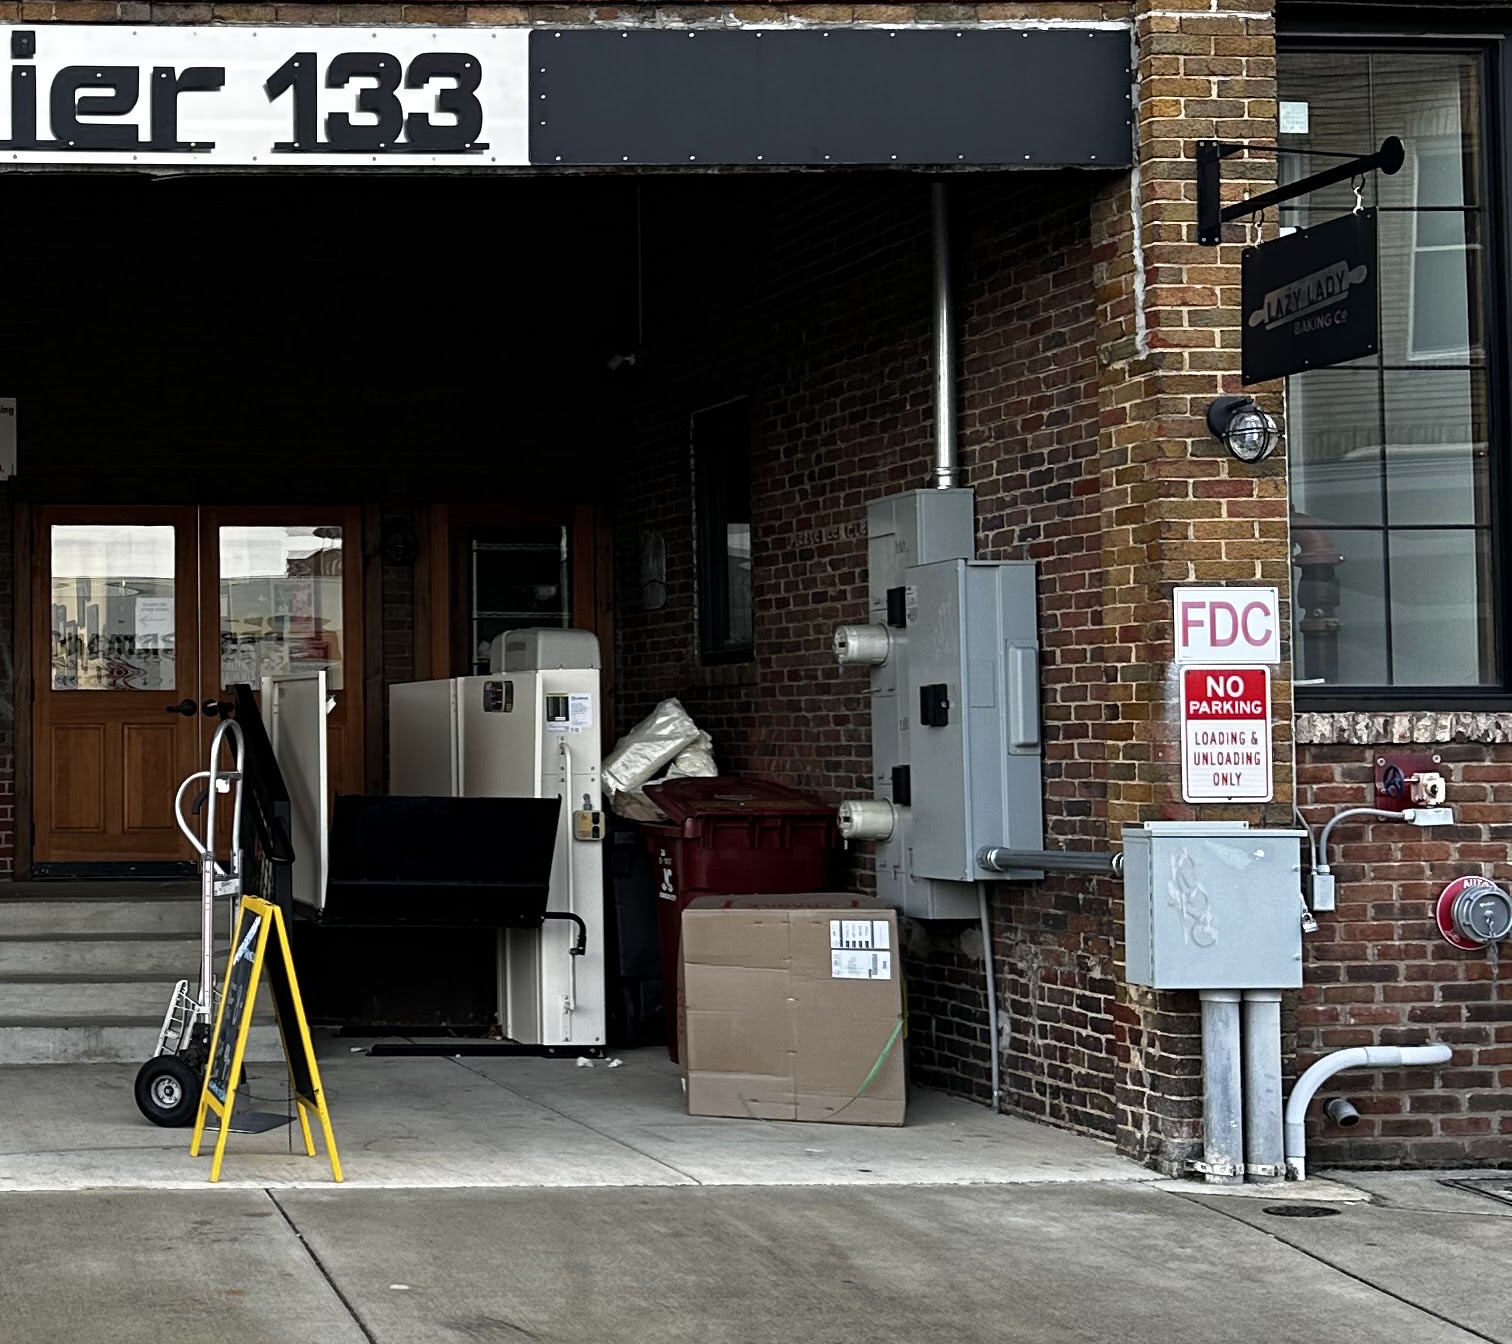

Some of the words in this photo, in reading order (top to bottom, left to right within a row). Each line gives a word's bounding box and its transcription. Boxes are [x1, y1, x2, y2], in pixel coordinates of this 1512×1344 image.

[264, 51, 489, 152] 133
[1267, 287, 1302, 321] LAZY
[1307, 270, 1345, 304] LADY
[1294, 313, 1332, 335] BAKING
[1181, 601, 1273, 647] FDC
[1206, 675, 1245, 698] NO
[1189, 700, 1263, 714] PARKING
[1194, 731, 1246, 745] LOADING
[1251, 731, 1258, 745] &
[1193, 751, 1261, 766] UNLOADING
[1213, 772, 1242, 787] ONLY
